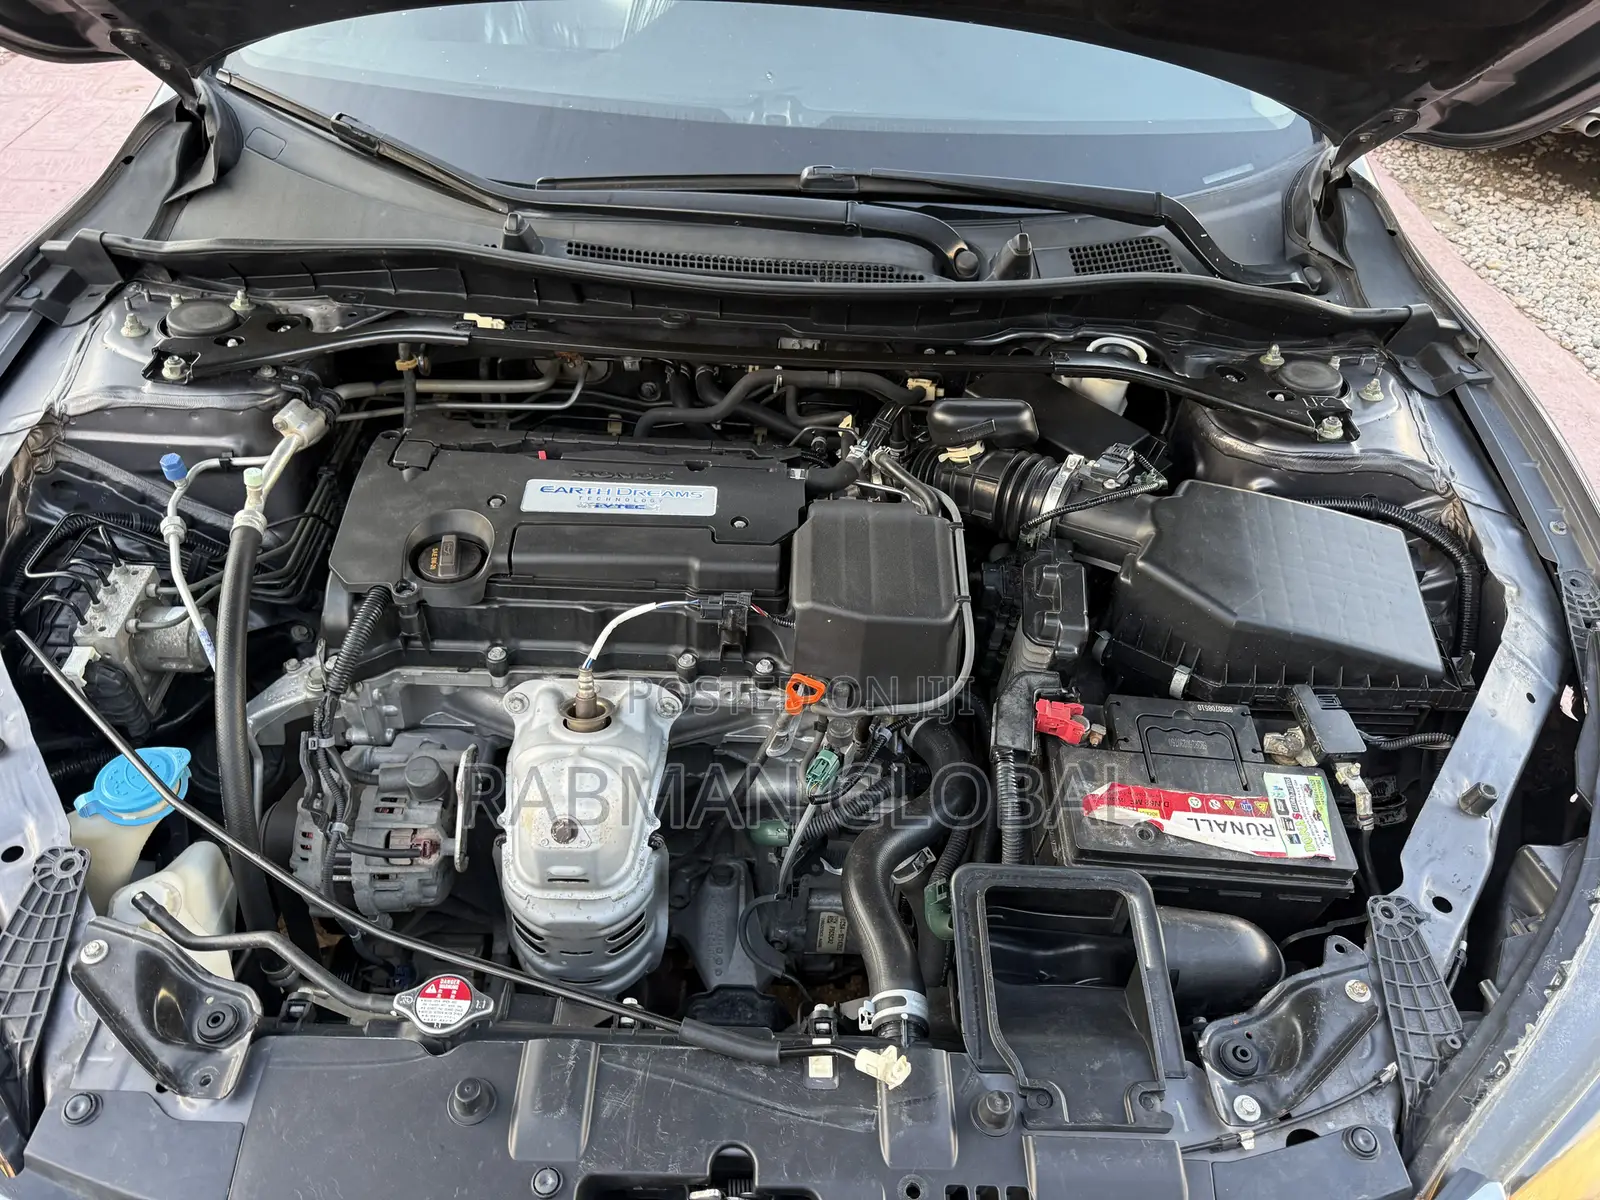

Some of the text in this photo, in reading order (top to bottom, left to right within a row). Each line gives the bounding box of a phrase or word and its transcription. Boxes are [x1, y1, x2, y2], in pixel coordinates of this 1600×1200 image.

[540, 485, 704, 499] EARTH DREAMS
[578, 495, 664, 503] TECHNOLOGY
[1186, 817, 1276, 838] RUNALL
